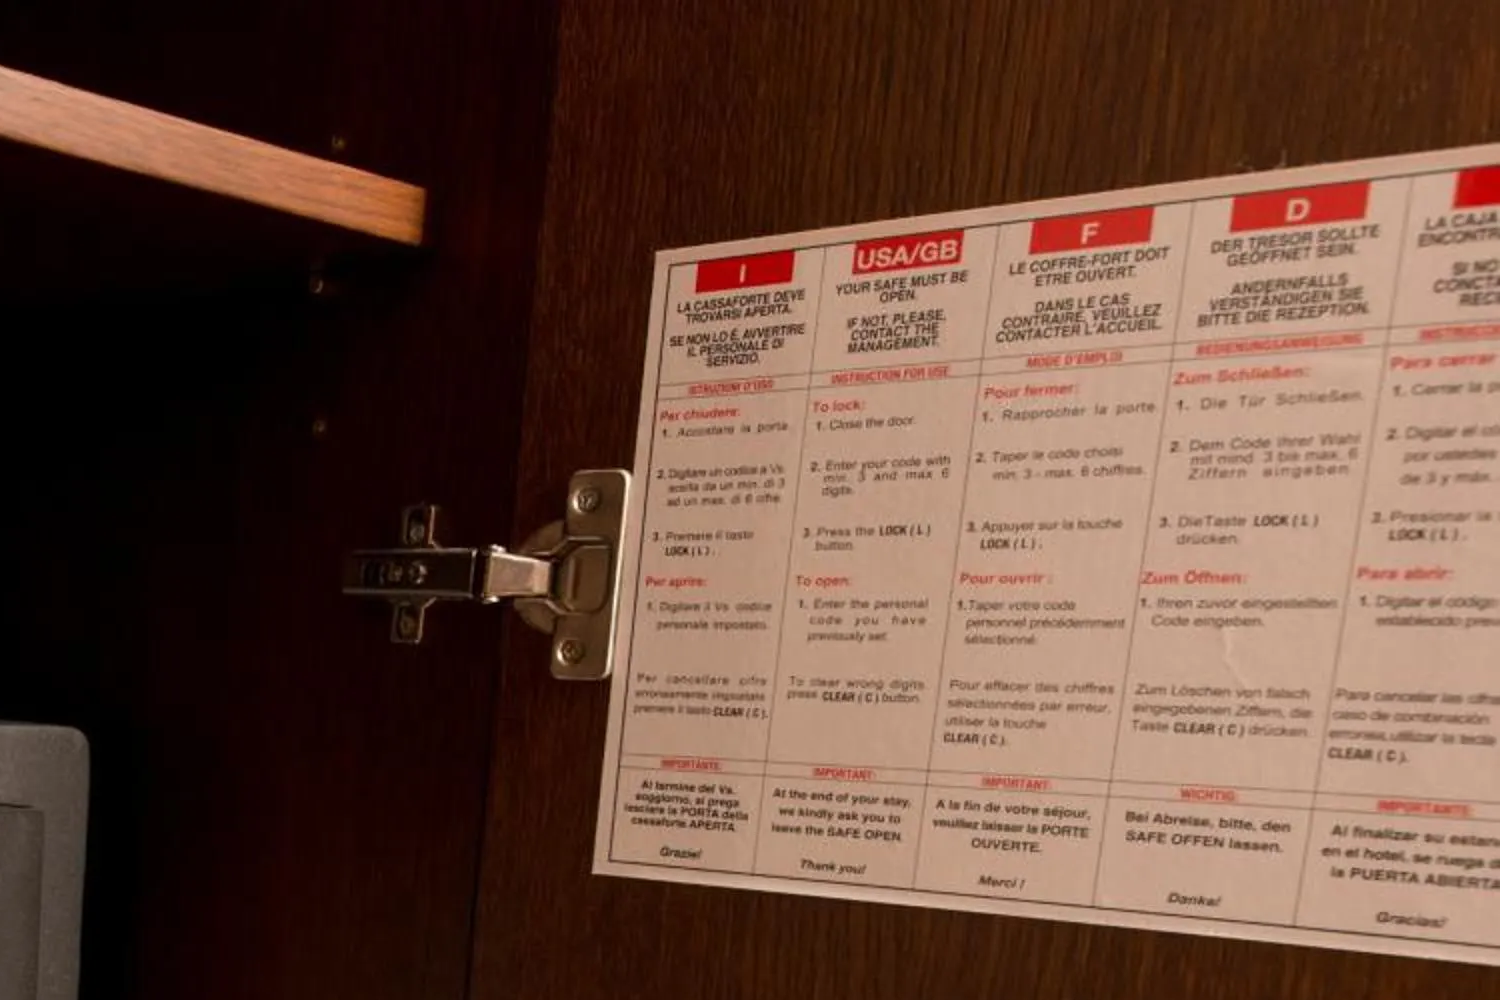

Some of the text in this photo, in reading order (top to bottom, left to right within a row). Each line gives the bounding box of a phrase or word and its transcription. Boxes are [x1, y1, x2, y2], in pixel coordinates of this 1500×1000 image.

[1285, 198, 1311, 222] D
[1425, 212, 1498, 230] LA CAJA
[1081, 222, 1099, 244] F
[1210, 224, 1380, 254] DER TRESOR SOLLTE
[857, 239, 958, 270] USA/GB
[1009, 246, 1171, 275] LE COFFRE-FORT DOIT
[1452, 259, 1498, 275] SI NO
[836, 270, 968, 296] YOUR SAFE MUST BE
[1035, 272, 1072, 287] ETRE
[1231, 272, 1349, 295] ANDERNFALLS
[677, 288, 805, 313] LA CASSAFORTE DEVE
[1339, 286, 1364, 300] SIE
[1035, 293, 1131, 313] DANS LE CAS
[685, 309, 742, 324] TROVARSI
[1092, 304, 1162, 321] VEUILLEZ
[1197, 312, 1242, 328] BITTE
[1245, 309, 1271, 323] DIE
[847, 317, 858, 329] IF
[669, 323, 805, 347] SE NON LO AVVERTIRE
[851, 322, 939, 341] CONTACT THE
[996, 324, 1081, 343] CONTACTER
[700, 338, 784, 356] PERSONALE DI
[1390, 356, 1432, 370] Para
[1174, 373, 1212, 386] Zum
[985, 387, 1019, 400] Pour
[814, 402, 829, 413] To
[1201, 397, 1227, 410] Die
[1002, 403, 1155, 422] Rapprocher porte
[829, 417, 884, 431] Close the
[1189, 437, 1271, 452] Dem Code
[825, 455, 951, 471] Enter code with
[992, 451, 1028, 463] Taper
[1047, 450, 1080, 460] code
[873, 472, 898, 481] and
[981, 518, 1123, 533] Appuyer sur touche
[1253, 515, 1289, 527] LOCK
[816, 525, 907, 537] Press the LOCK
[980, 539, 1010, 550] LOCK
[797, 576, 811, 586] To
[960, 573, 994, 585] Pour
[1141, 572, 1179, 585] Zum
[814, 598, 929, 610] Enter the personal
[1008, 601, 1076, 611] votre code
[809, 615, 927, 626] code you have
[1151, 614, 1190, 627] Code
[822, 691, 855, 702] CLEAR
[1135, 684, 1168, 695] Zum
[1173, 722, 1215, 735] CLEAR
[943, 733, 979, 744] CLEAR
[773, 788, 786, 798] At
[789, 789, 807, 799] the
[810, 791, 833, 801] end
[852, 795, 880, 807] your
[681, 806, 718, 818] PORTA
[964, 800, 981, 811] fin
[984, 802, 1001, 812] de
[1005, 805, 1040, 815] votre
[779, 807, 901, 824] we kindly ask you to
[1125, 811, 1149, 823] Bei
[1261, 821, 1291, 833] den
[772, 823, 801, 833] leave
[805, 826, 824, 836] the
[827, 827, 861, 839] SAFE
[1041, 823, 1089, 838] PORTE
[1353, 826, 1444, 843] finalizar su
[1125, 829, 1167, 844] SAFE
[1171, 833, 1224, 848] OFFEN
[801, 859, 835, 871] Thank
[1350, 867, 1420, 883] PUERTA
